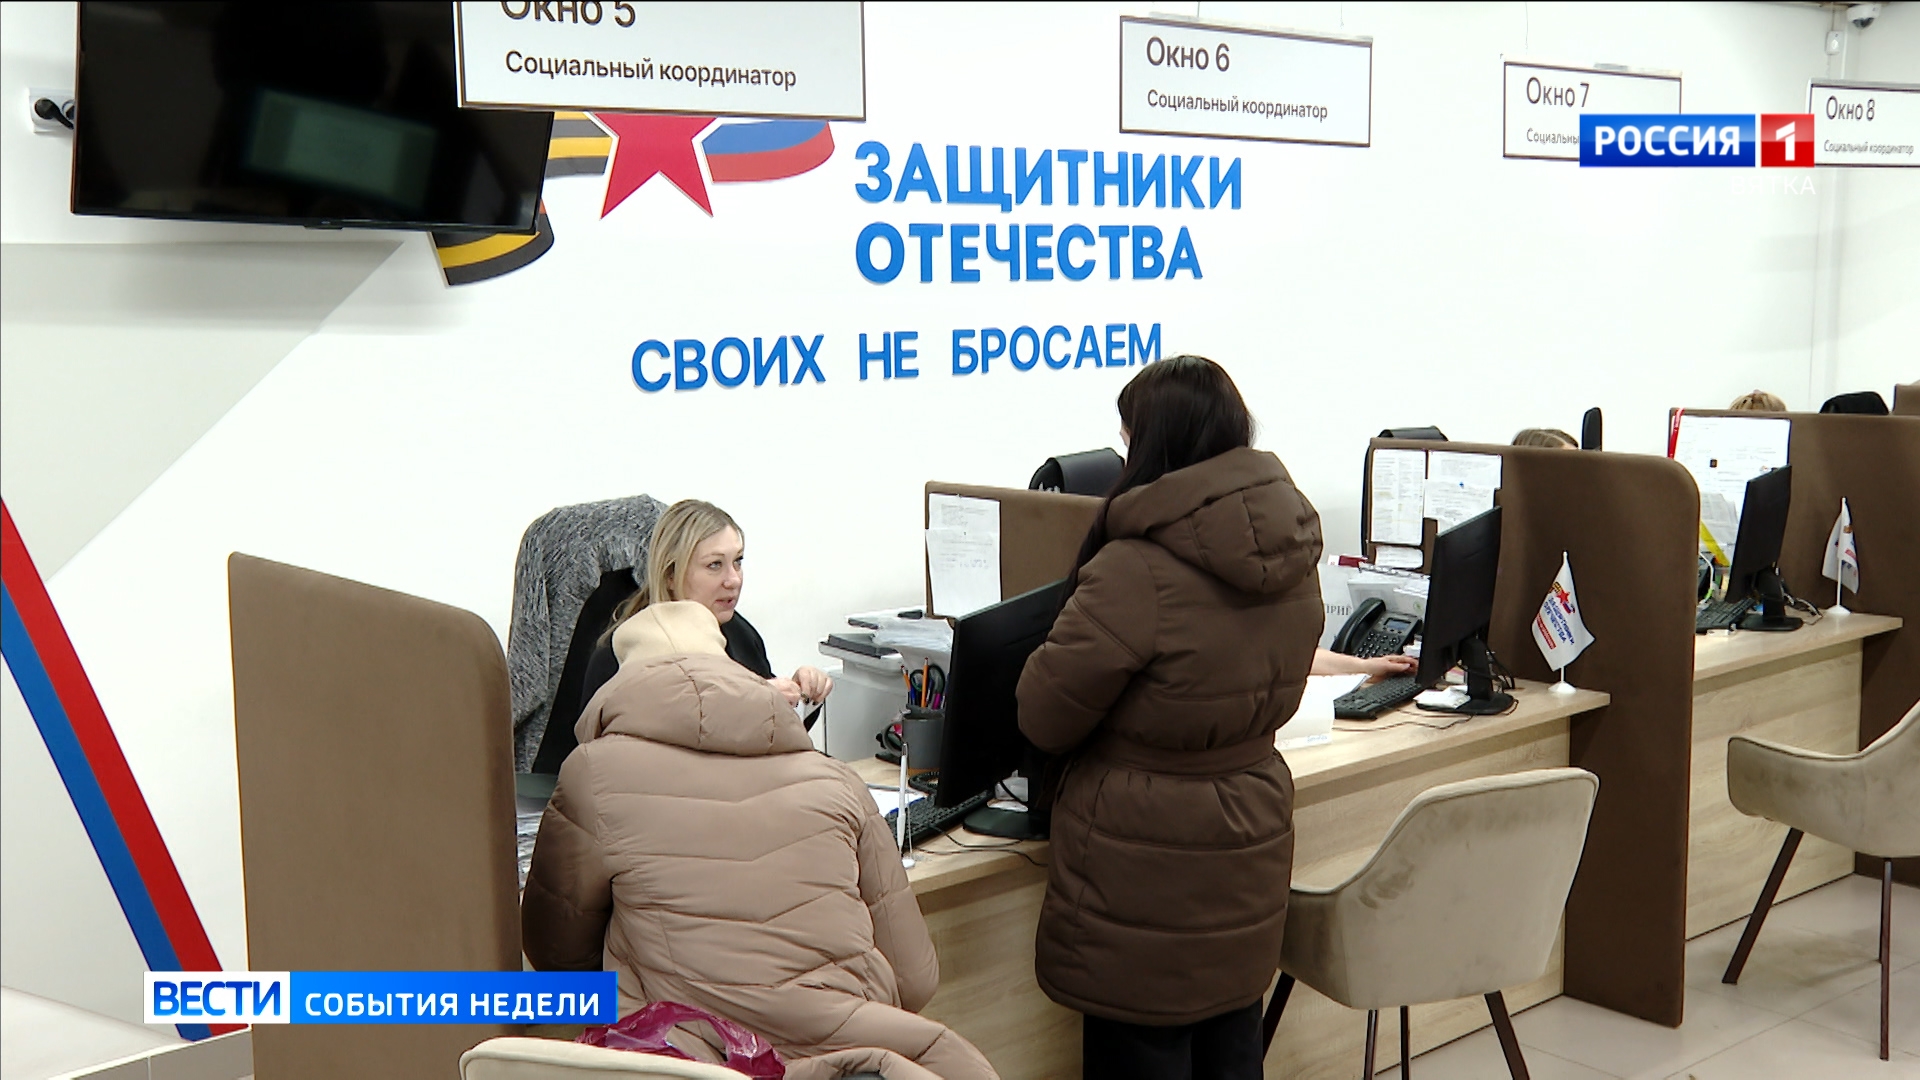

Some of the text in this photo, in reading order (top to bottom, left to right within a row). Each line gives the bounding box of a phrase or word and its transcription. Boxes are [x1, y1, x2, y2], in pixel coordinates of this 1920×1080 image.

[506, 50, 797, 91] Социальный координатор
[1146, 36, 1230, 72] Окно 6
[1147, 88, 1328, 122] Социальный координатор
[1526, 76, 1590, 108] Окно 7
[1825, 95, 1876, 121] Окно 8
[1526, 127, 1579, 146] Социальны
[855, 140, 1242, 214] ЗАЩИТНИКИ
[855, 222, 1203, 285] ОТЕЧЕСТВА
[631, 322, 1162, 393] СВОИХ НЕ БРОСАЕМ
